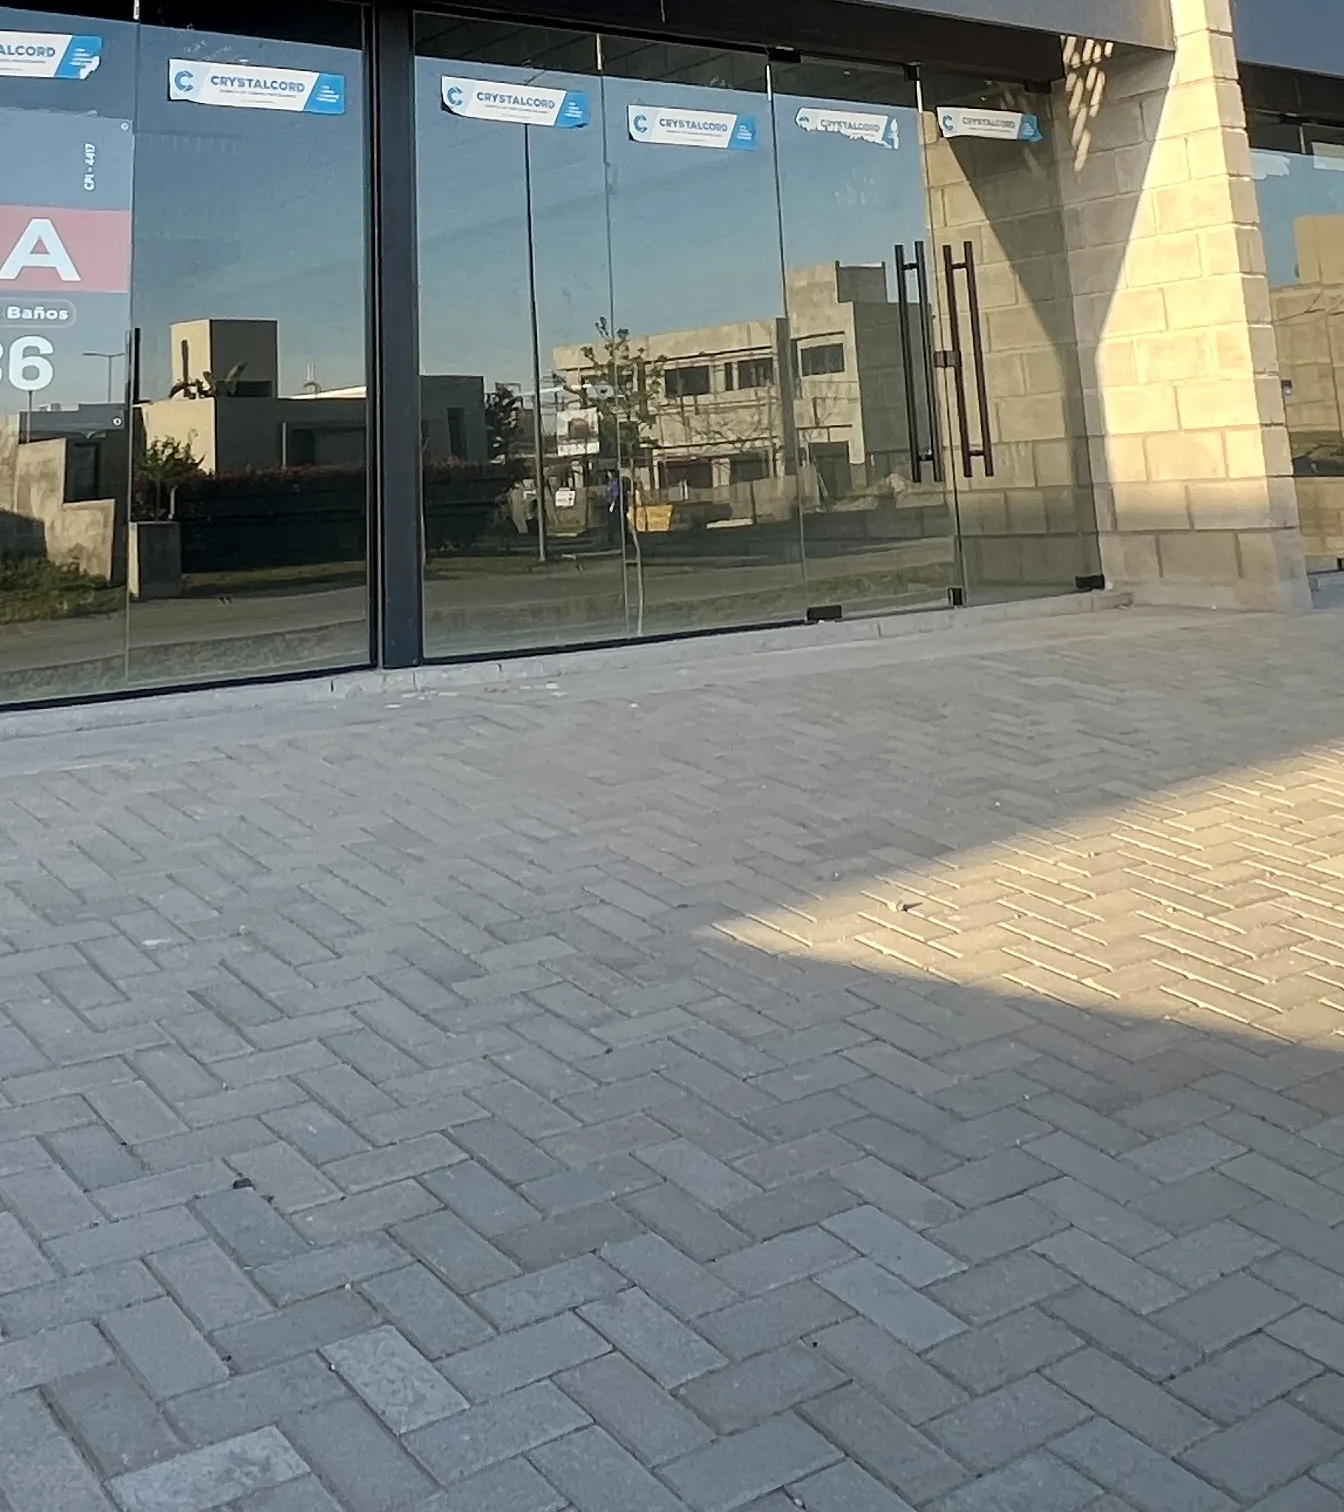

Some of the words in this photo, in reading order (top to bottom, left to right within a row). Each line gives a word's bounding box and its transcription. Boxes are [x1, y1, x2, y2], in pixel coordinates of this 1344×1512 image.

[210, 75, 305, 93] CRYSTALCORD
[476, 92, 556, 109] CRYSTALCORD
[659, 118, 728, 133] CRYSTALCORD
[6, 306, 69, 320] Baños
